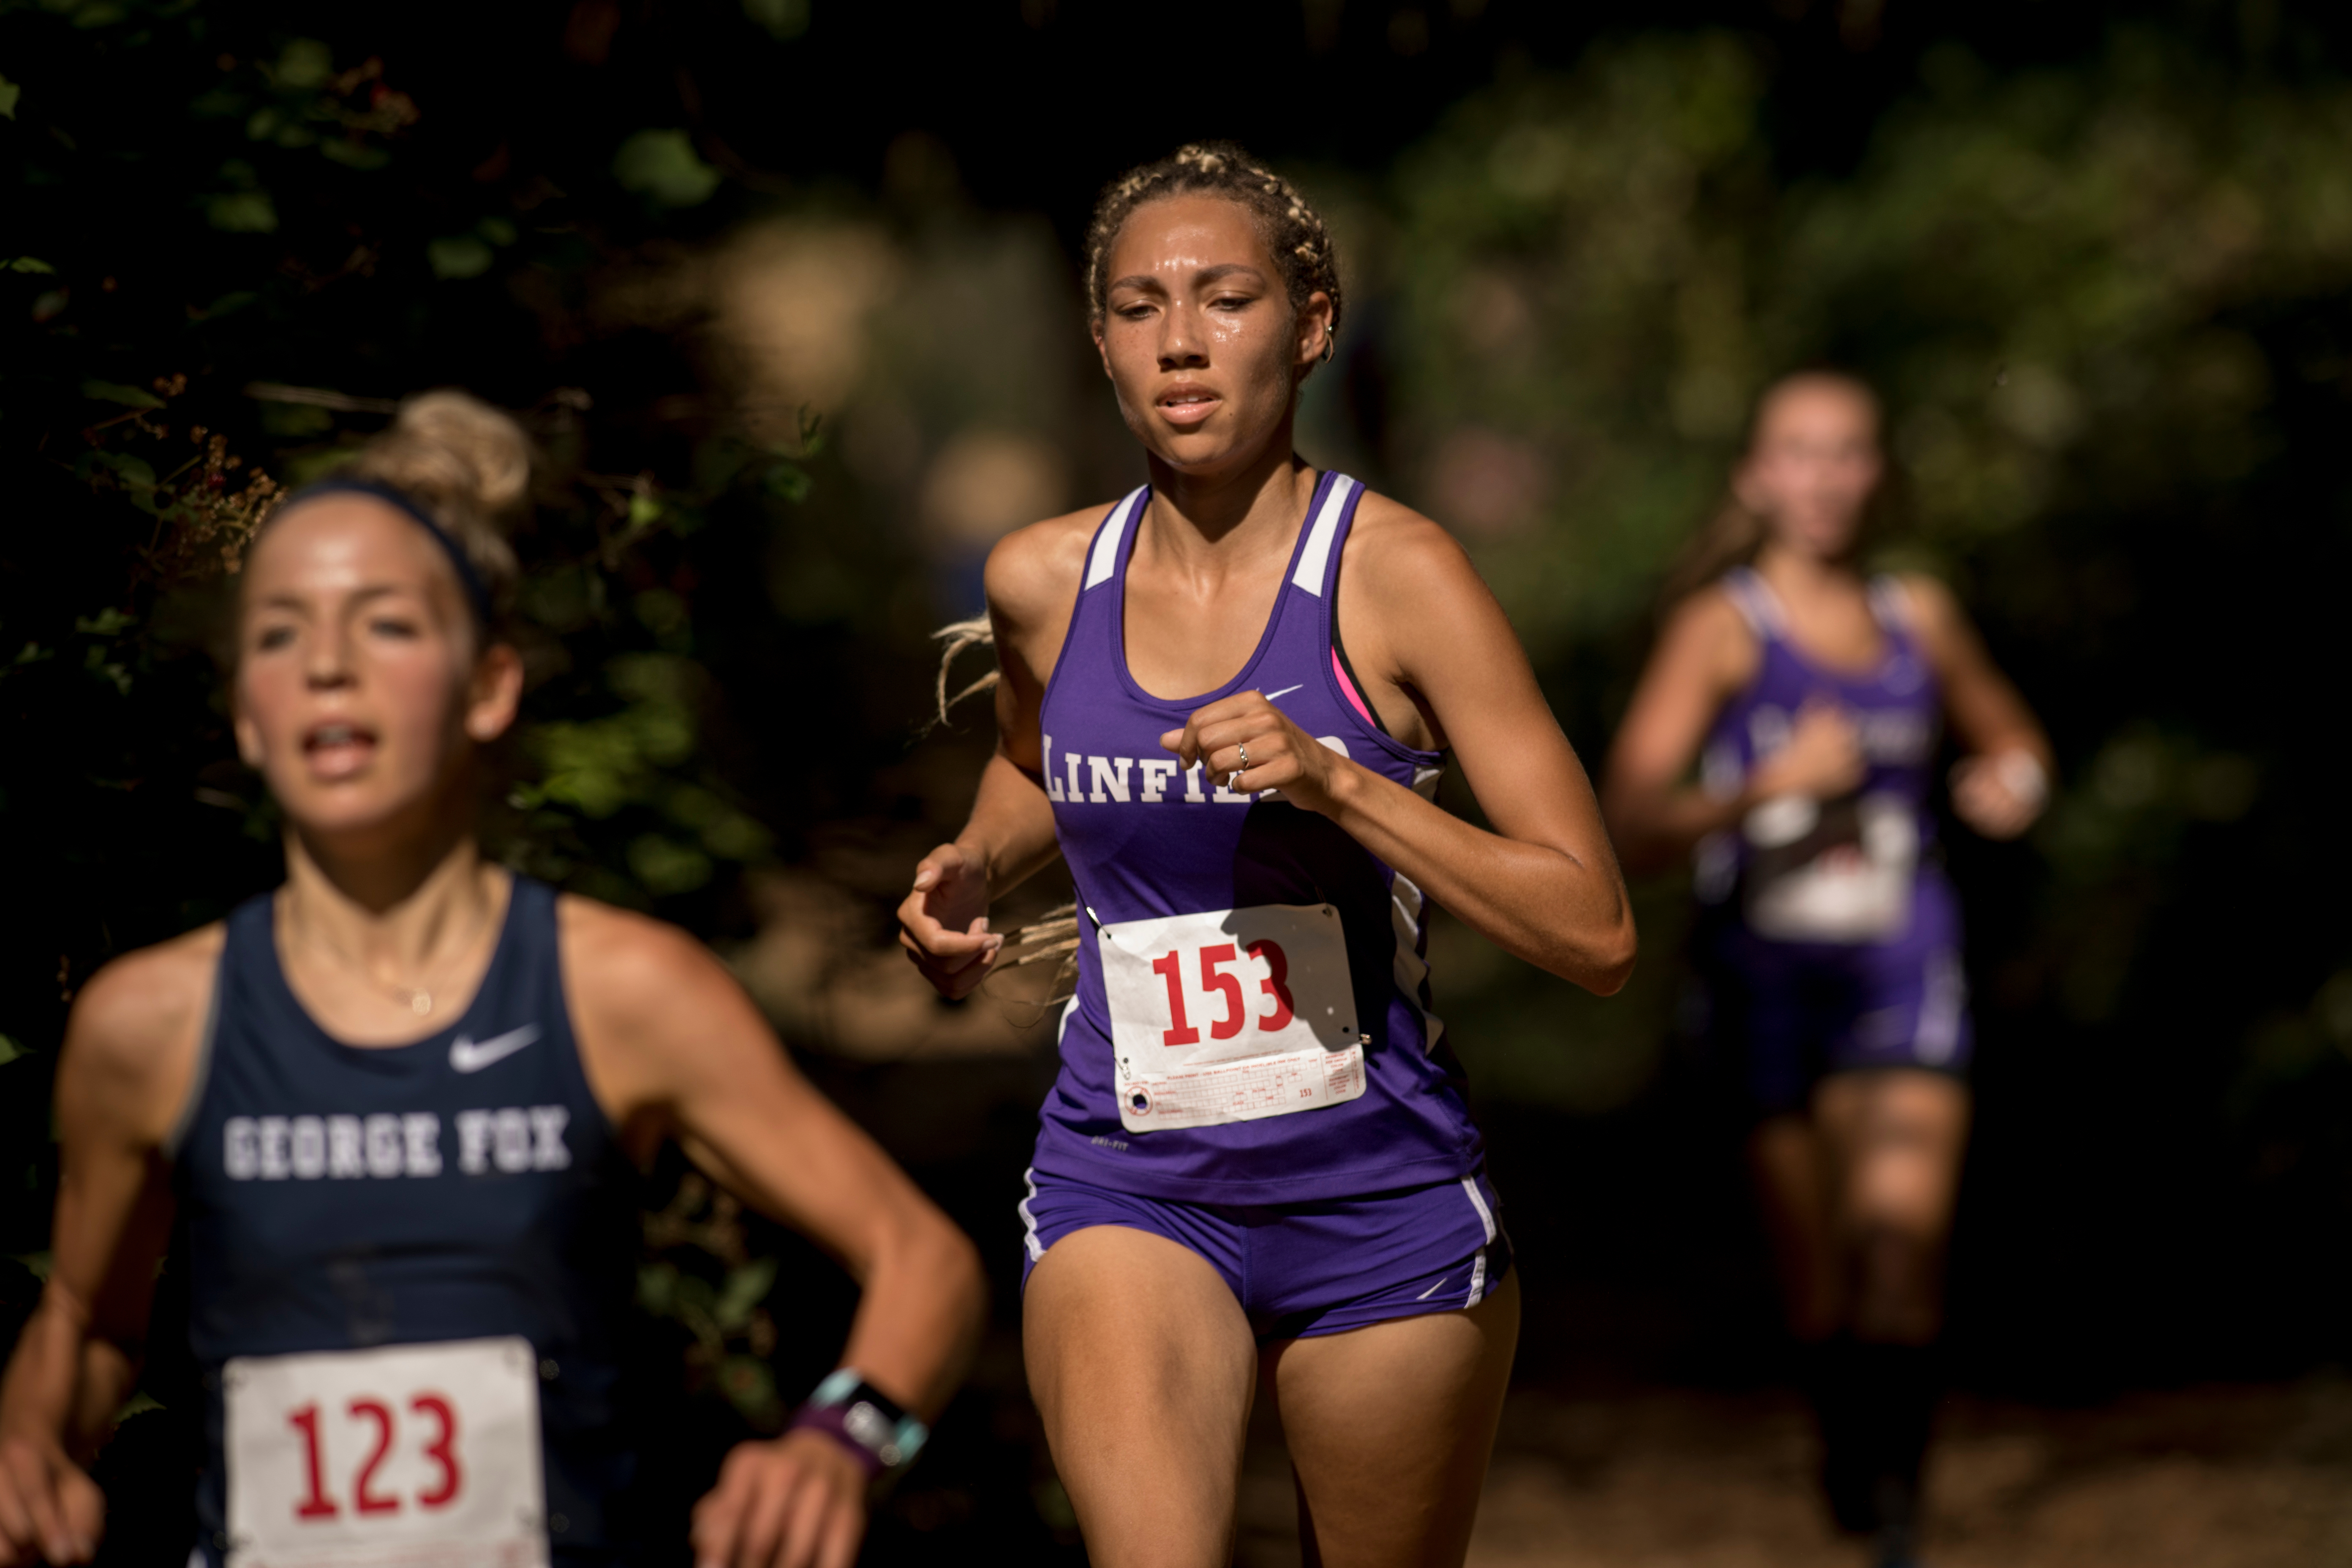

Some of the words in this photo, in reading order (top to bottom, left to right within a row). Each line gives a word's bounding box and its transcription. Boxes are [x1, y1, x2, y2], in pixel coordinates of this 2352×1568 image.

[1152, 938, 1294, 1047] 153
[1213, 1066, 1241, 1074] BALLPOINT
[1299, 1087, 1312, 1098] 153
[223, 1113, 443, 1180] GEORGE
[455, 1105, 572, 1175] FOX
[286, 1391, 466, 1522] 123
